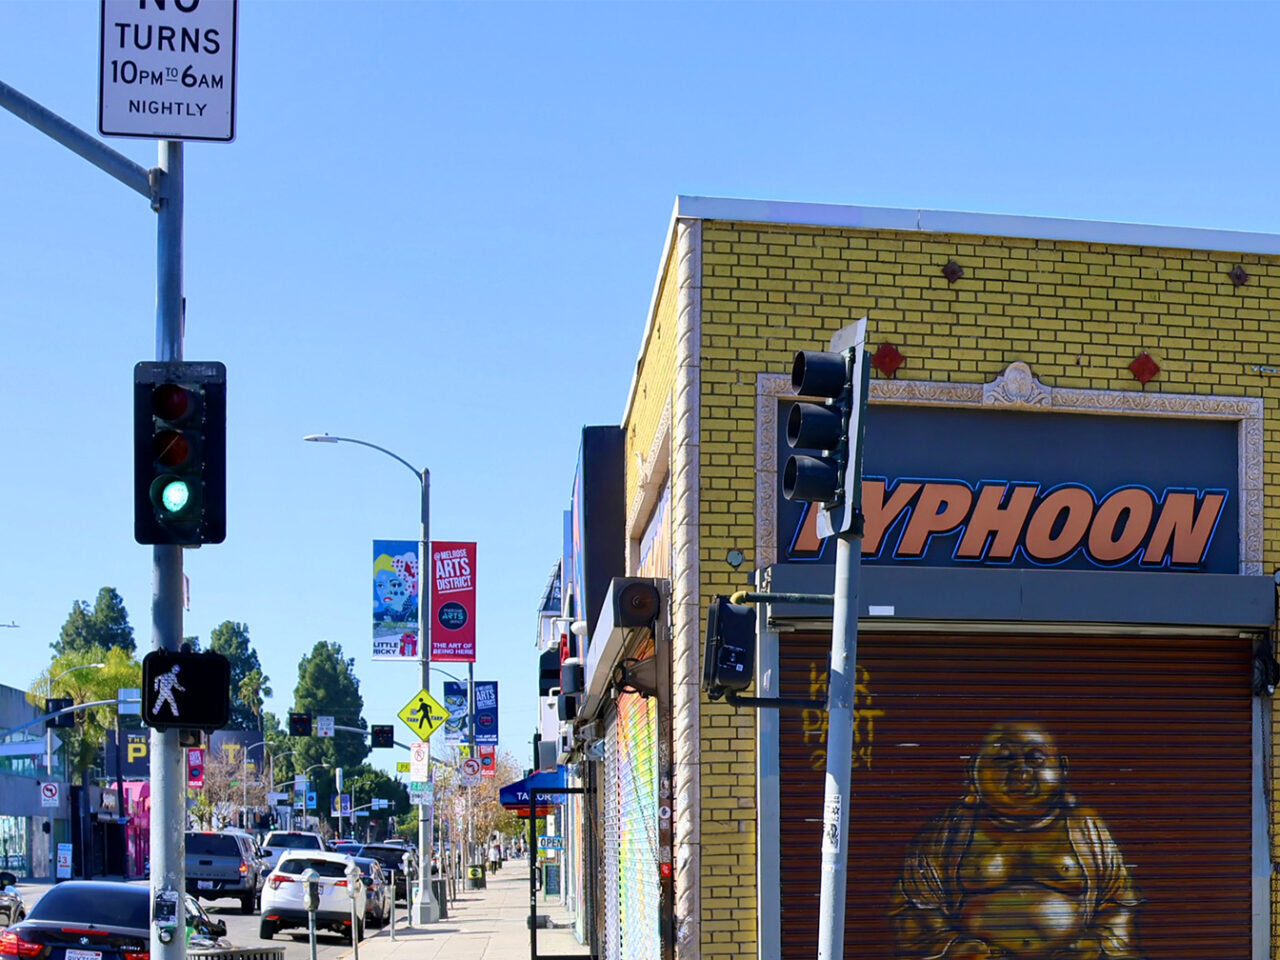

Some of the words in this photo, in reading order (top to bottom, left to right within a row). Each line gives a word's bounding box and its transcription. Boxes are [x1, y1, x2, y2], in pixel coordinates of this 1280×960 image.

[114, 22, 220, 54] TURNS
[111, 60, 163, 86] 10PM
[165, 67, 178, 82] TO
[181, 65, 224, 89] 6AM
[129, 99, 207, 116] NIGHTLY
[436, 557, 471, 579] ARTS
[436, 575, 472, 591] DISTRICT
[516, 792, 552, 801] TAOR
[540, 838, 563, 847] OPEN
